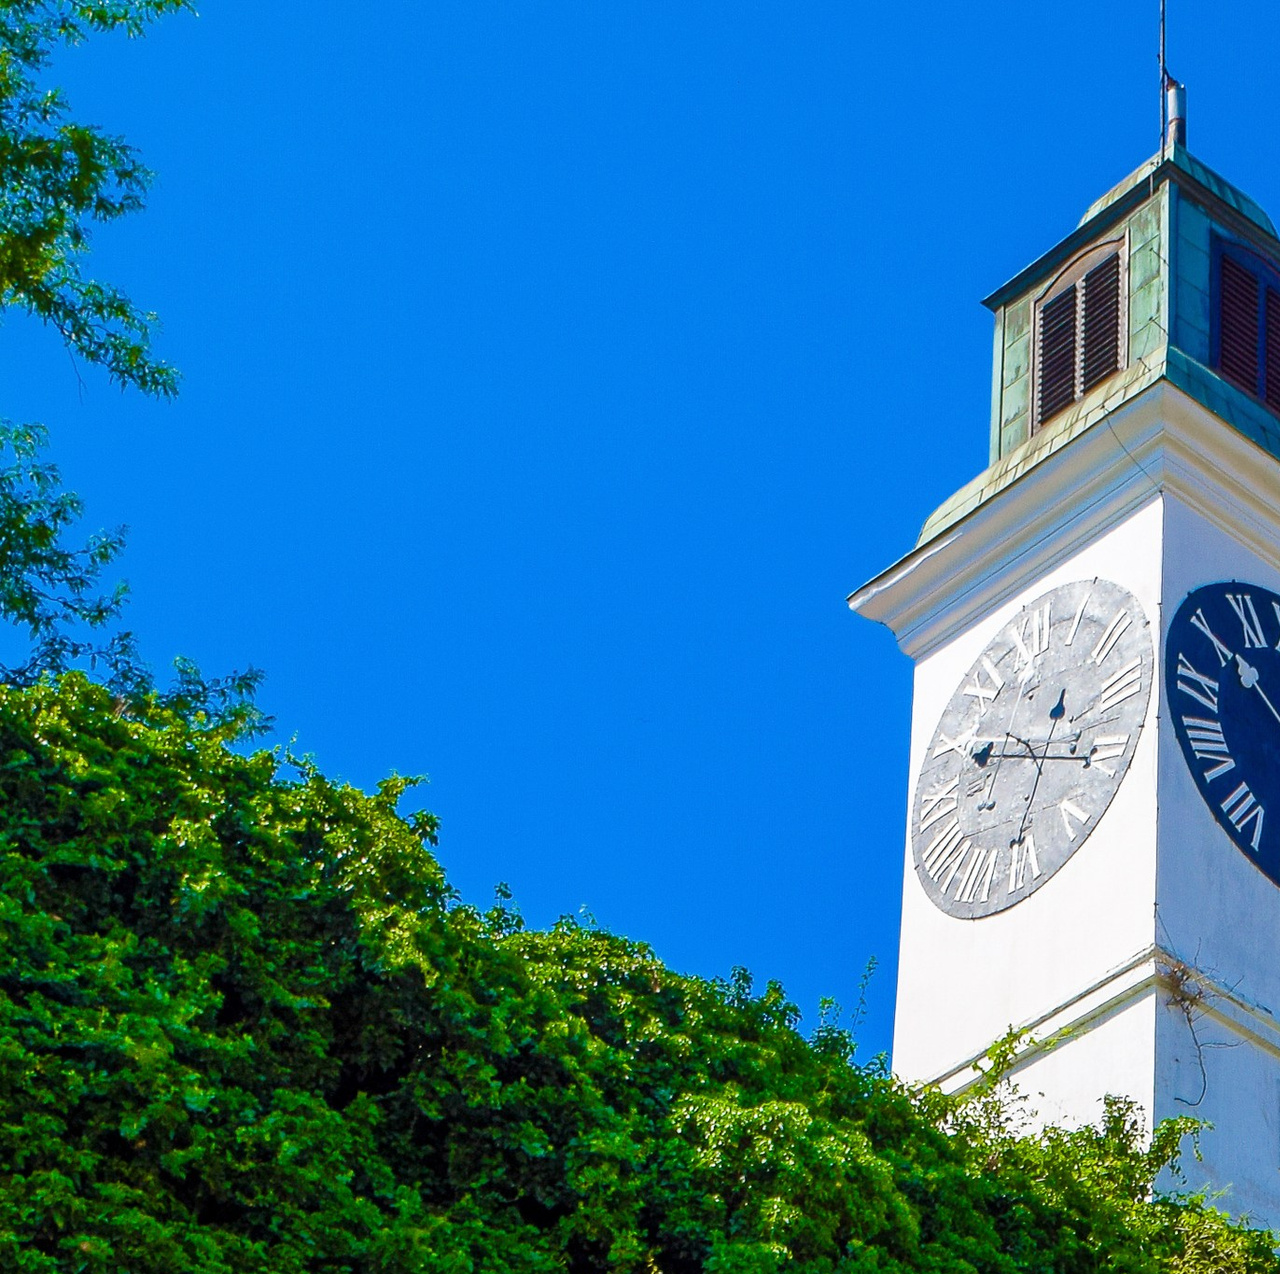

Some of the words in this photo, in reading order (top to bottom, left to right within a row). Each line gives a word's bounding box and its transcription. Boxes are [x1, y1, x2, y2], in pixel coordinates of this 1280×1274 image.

[1091, 607, 1132, 667] II
[1190, 607, 1234, 668] X
[1226, 593, 1268, 648] XI
[1101, 655, 1142, 714] III
[1177, 652, 1220, 714] IX
[1182, 715, 1237, 784] VIII
[1220, 781, 1266, 852] VII
